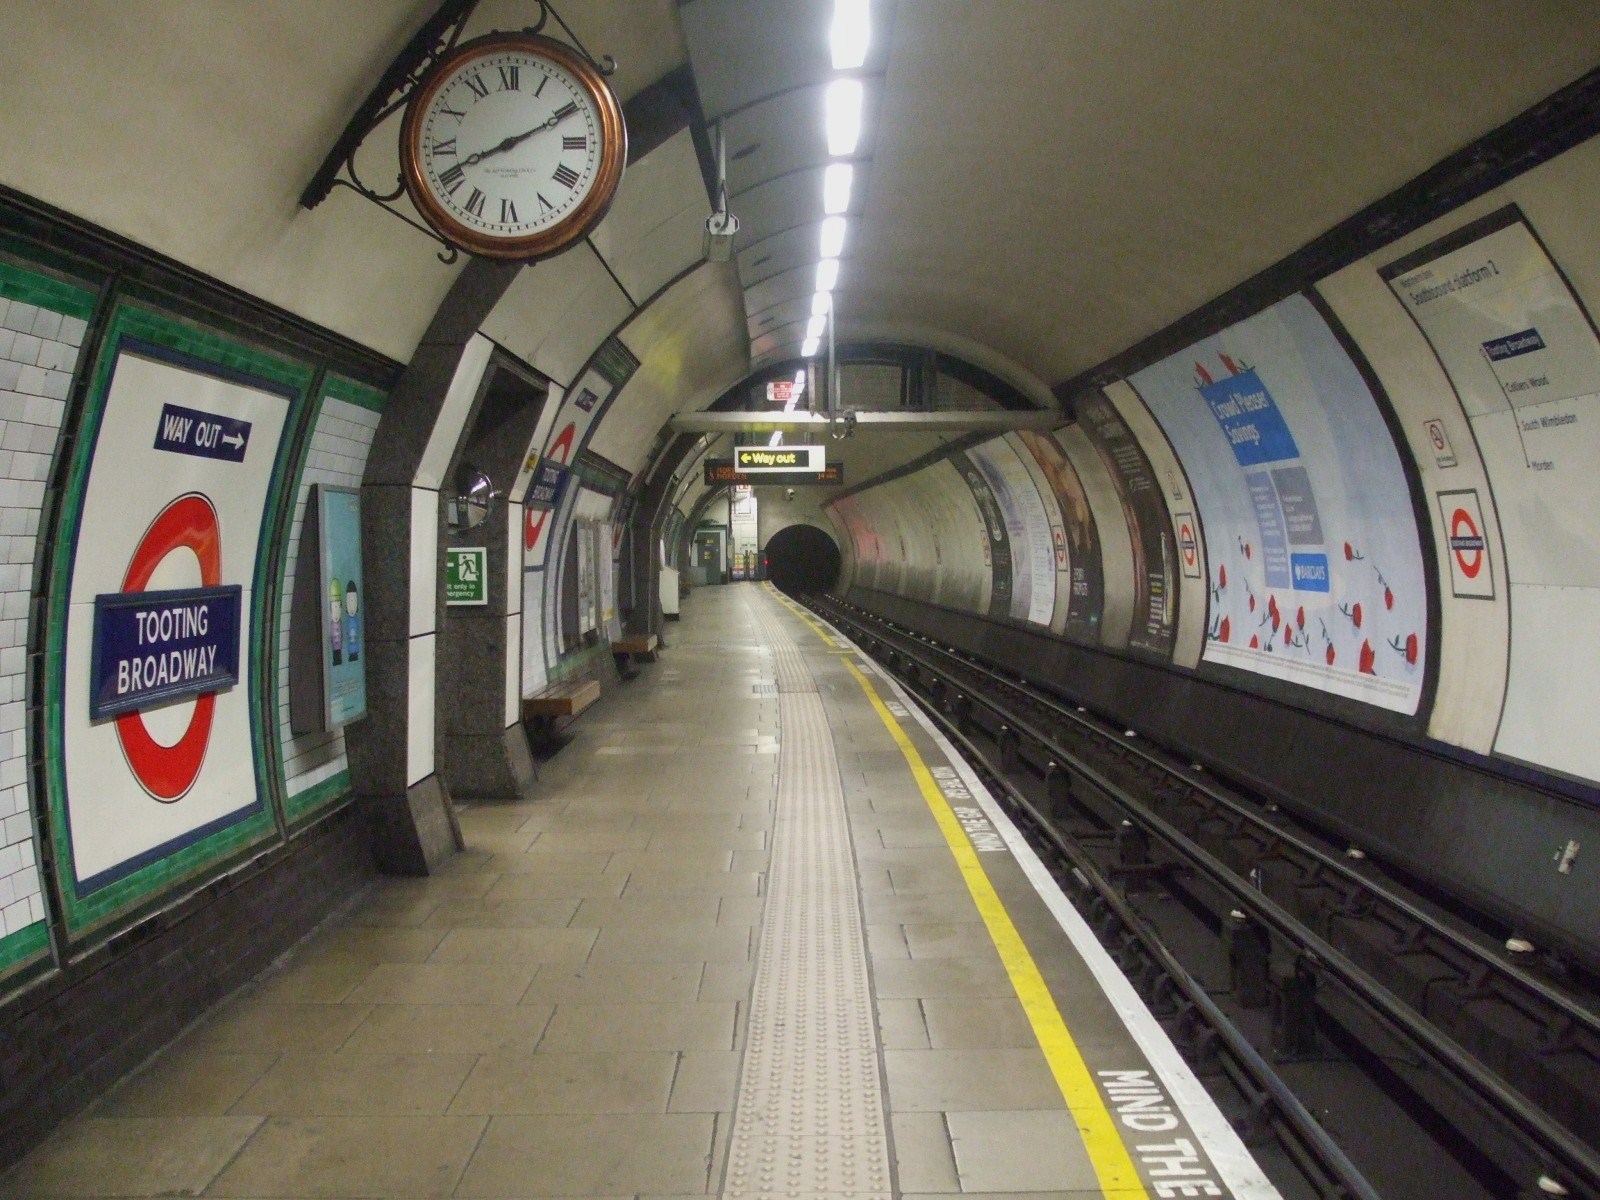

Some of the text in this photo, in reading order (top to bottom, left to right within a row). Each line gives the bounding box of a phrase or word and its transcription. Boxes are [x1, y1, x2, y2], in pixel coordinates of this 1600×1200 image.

[463, 72, 490, 103] XI
[497, 65, 521, 92] XII
[532, 73, 551, 99] I
[439, 101, 468, 127] X
[432, 135, 457, 158] IX
[562, 134, 587, 152] III
[464, 185, 487, 219] VII
[499, 198, 520, 224] VI
[536, 191, 557, 216] V
[1453, 266, 1489, 292] platform
[163, 414, 222, 449] WAY OUT
[1224, 421, 1260, 446] Savings
[752, 452, 796, 466] Way out
[1300, 565, 1326, 580] BARCLAYS
[135, 604, 209, 645] TOOTING
[117, 644, 217, 694] BROADWAY
[1097, 1070, 1222, 1198] MIND THE
